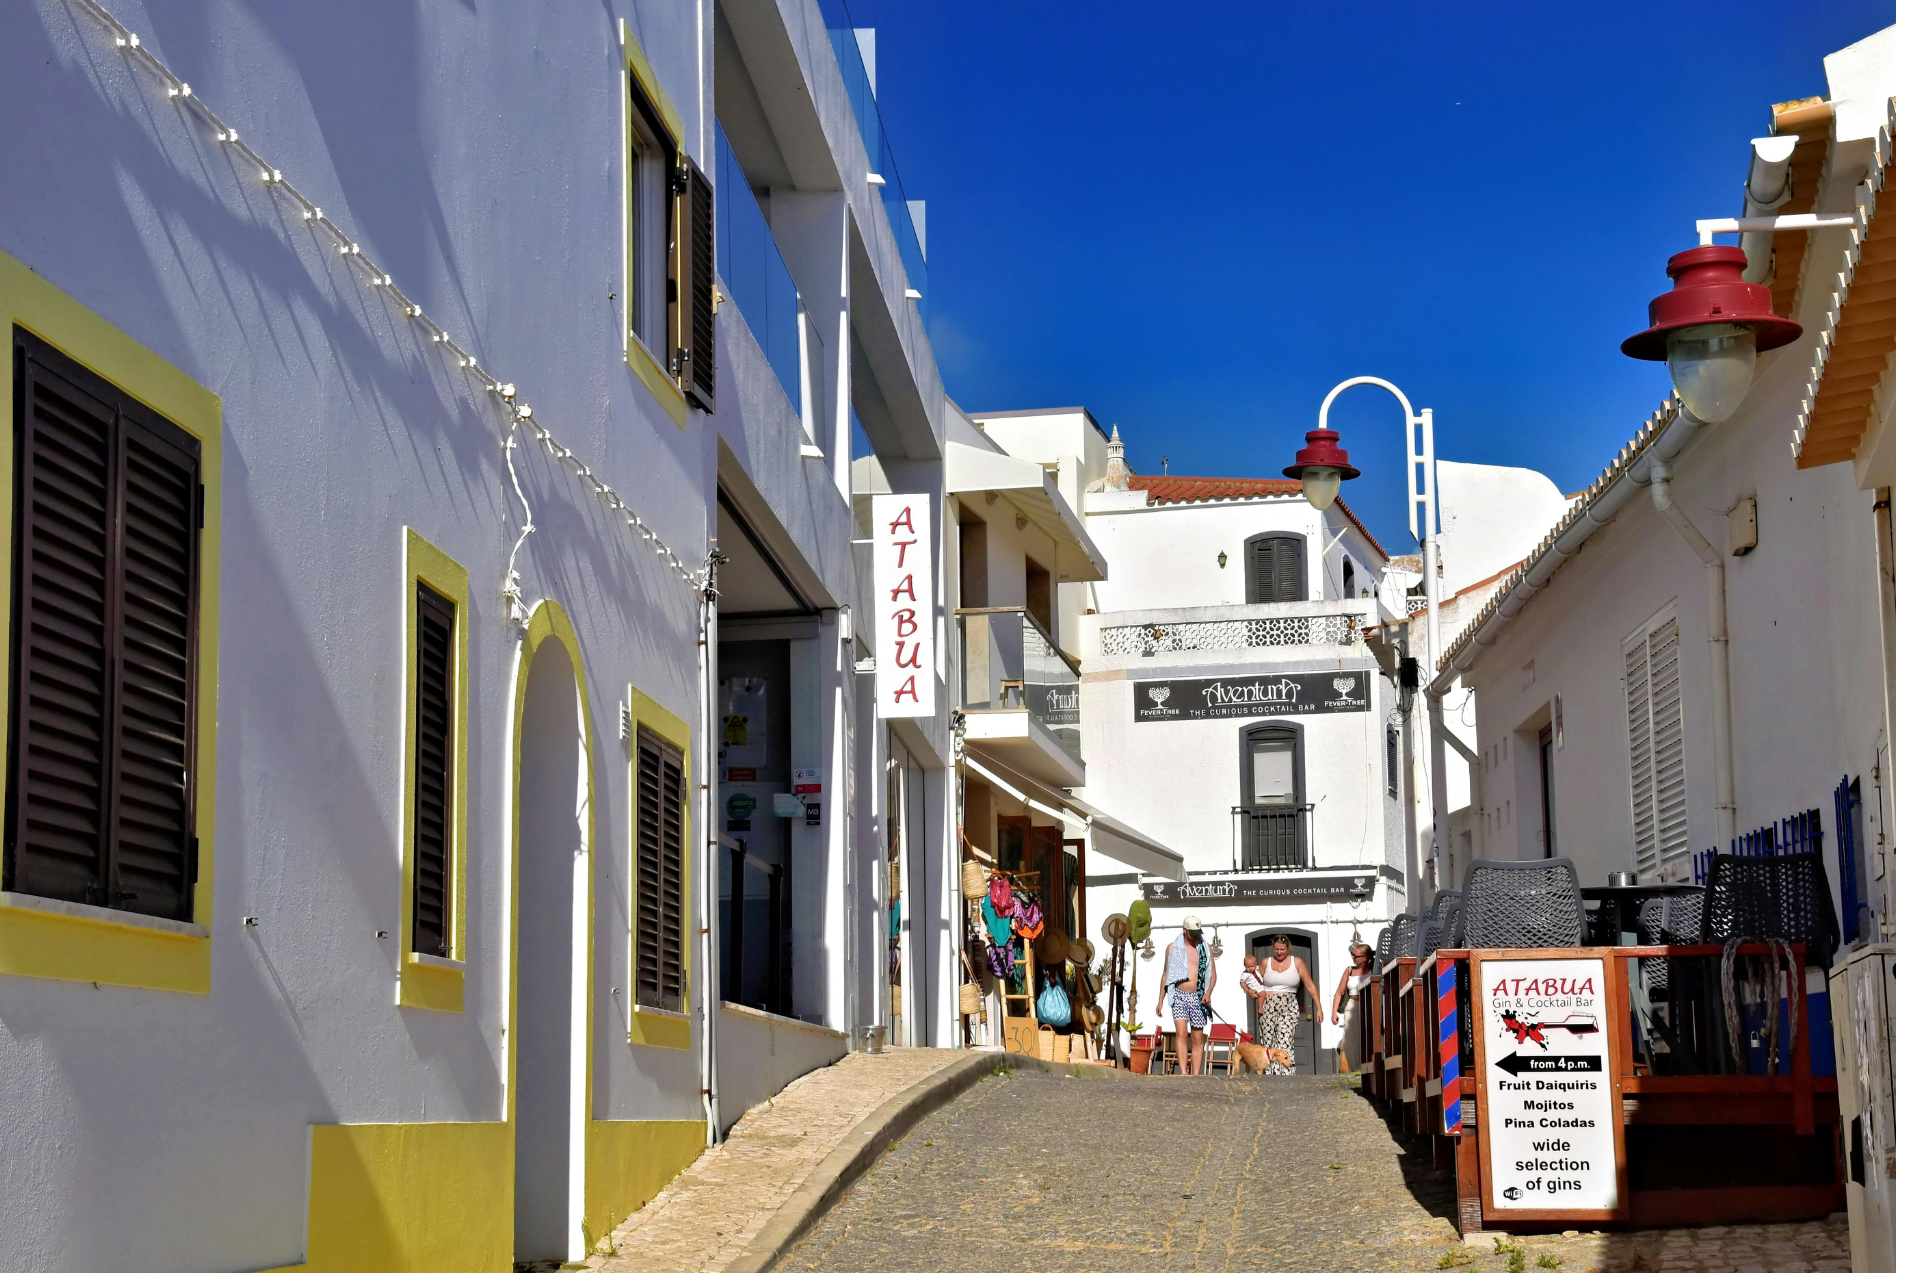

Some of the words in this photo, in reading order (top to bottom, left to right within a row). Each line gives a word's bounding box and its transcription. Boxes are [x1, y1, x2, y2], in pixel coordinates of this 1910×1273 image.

[889, 506, 922, 703] ATABUA
[1189, 709, 1208, 717] THE
[1209, 706, 1248, 716] CURIOUS
[1251, 704, 1295, 714] COCKTAIL
[1298, 703, 1316, 712] BAR
[1243, 889, 1257, 897] THE
[1259, 888, 1291, 896] CURIOUS
[1293, 887, 1328, 895] COCKTAIL
[1492, 977, 1595, 997] ATABUA
[1492, 998, 1512, 1008] Gin
[1515, 997, 1524, 1008] &
[1527, 997, 1572, 1008] Cocktail
[1576, 997, 1594, 1007] Bar
[1530, 1059, 1556, 1069] from
[1499, 1080, 1531, 1091] Fruit
[1535, 1080, 1597, 1093] Daiquiris
[1523, 1100, 1574, 1113] Mojitos
[1504, 1118, 1535, 1128] Pina
[1539, 1118, 1596, 1128] Coladas
[1532, 1139, 1571, 1152] wide
[1515, 1158, 1590, 1171] selection
[1525, 1176, 1542, 1190] of
[1547, 1178, 1582, 1194] gins
